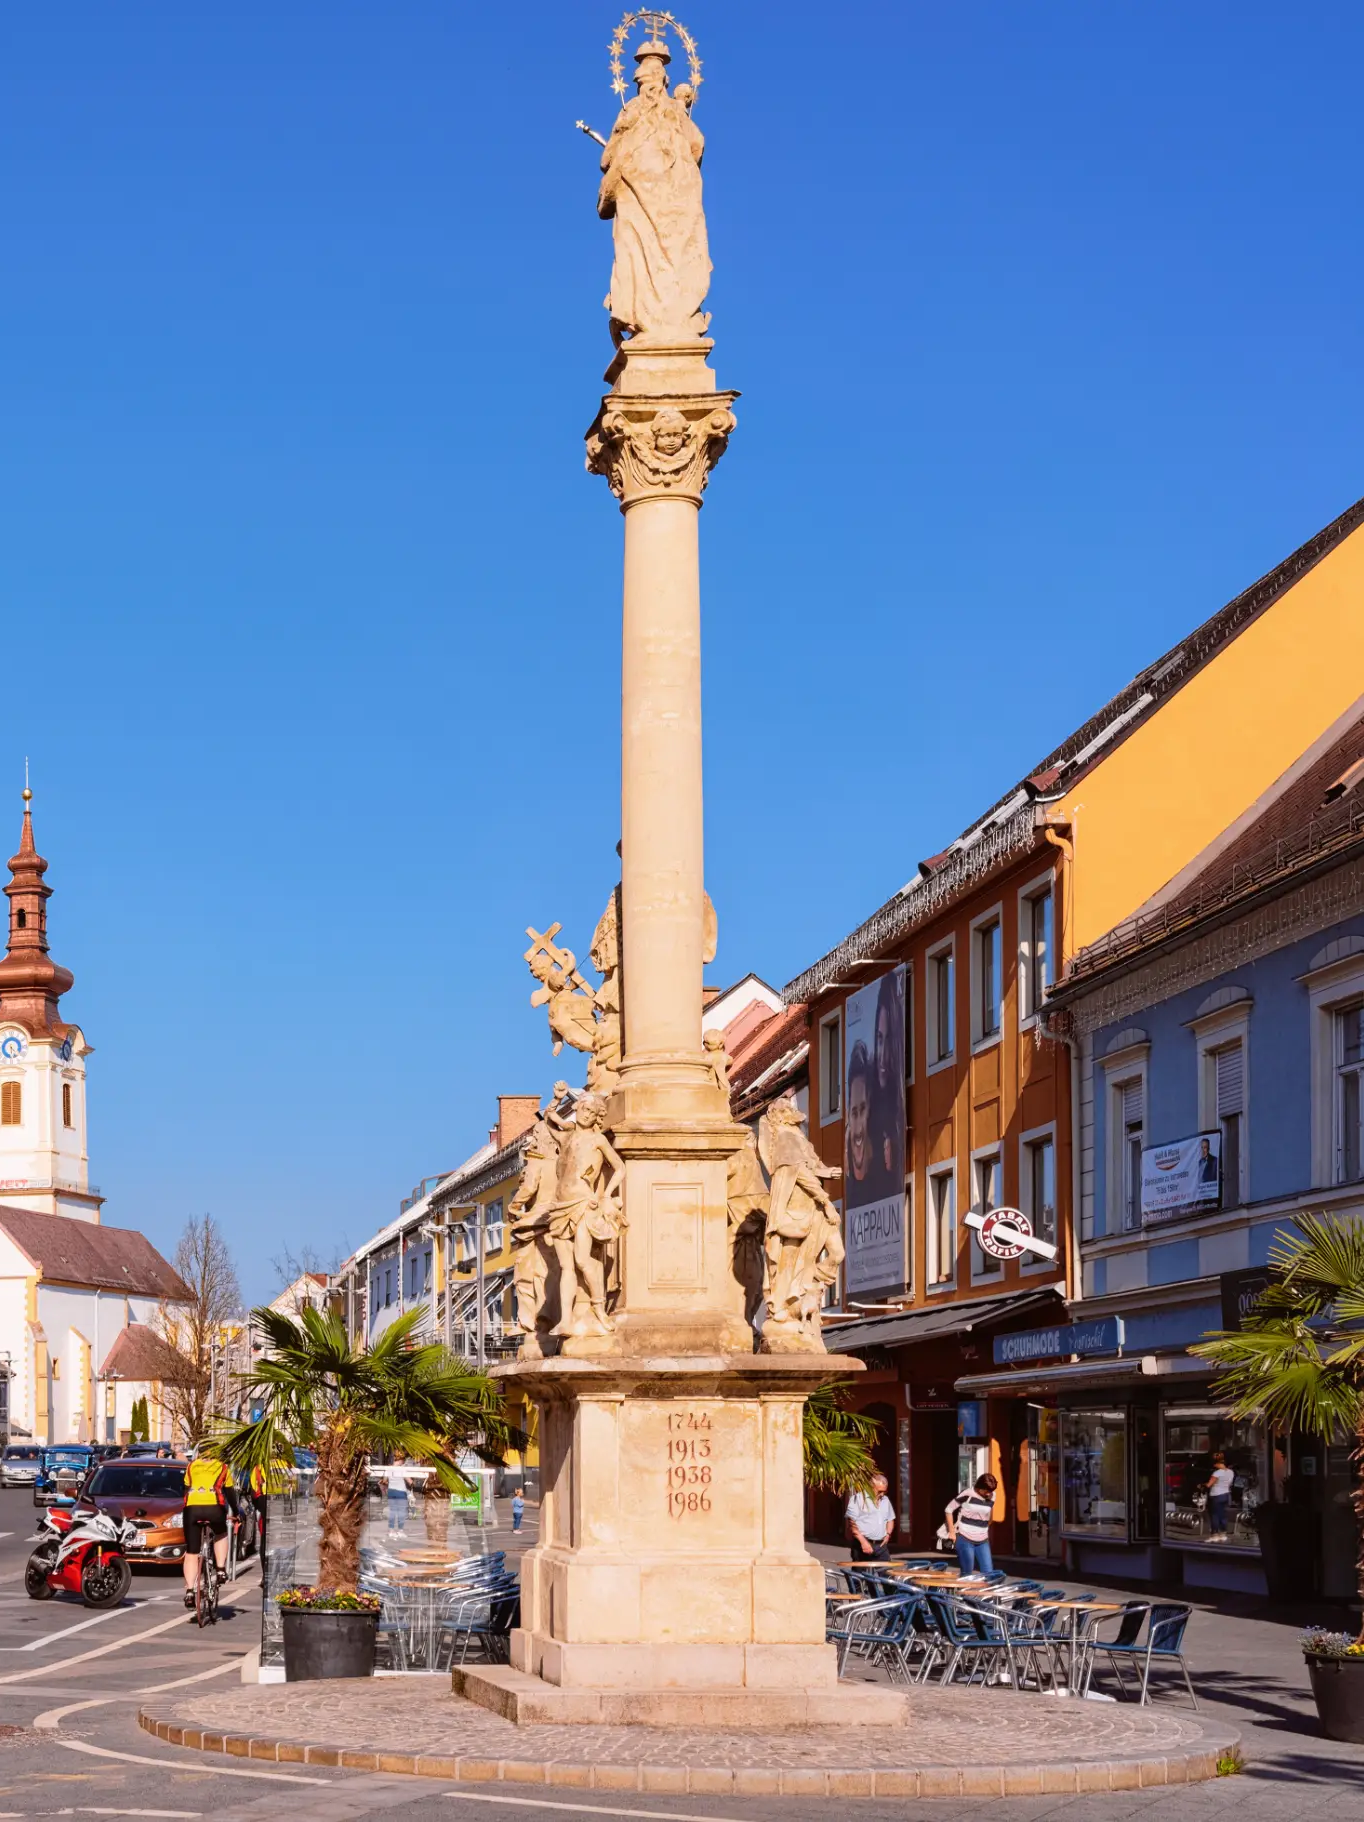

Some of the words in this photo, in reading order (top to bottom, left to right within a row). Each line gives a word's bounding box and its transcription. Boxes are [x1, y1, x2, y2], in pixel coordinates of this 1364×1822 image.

[850, 1201, 901, 1246] KAPPAUN
[990, 1211, 1030, 1233] TABAK
[983, 1229, 1019, 1256] TRAFIK
[1001, 1331, 1060, 1360] SCHUHMODE
[668, 1412, 714, 1434] 1744
[666, 1439, 712, 1463] 1913
[666, 1465, 713, 1489] 1938
[665, 1488, 712, 1521] 1986
